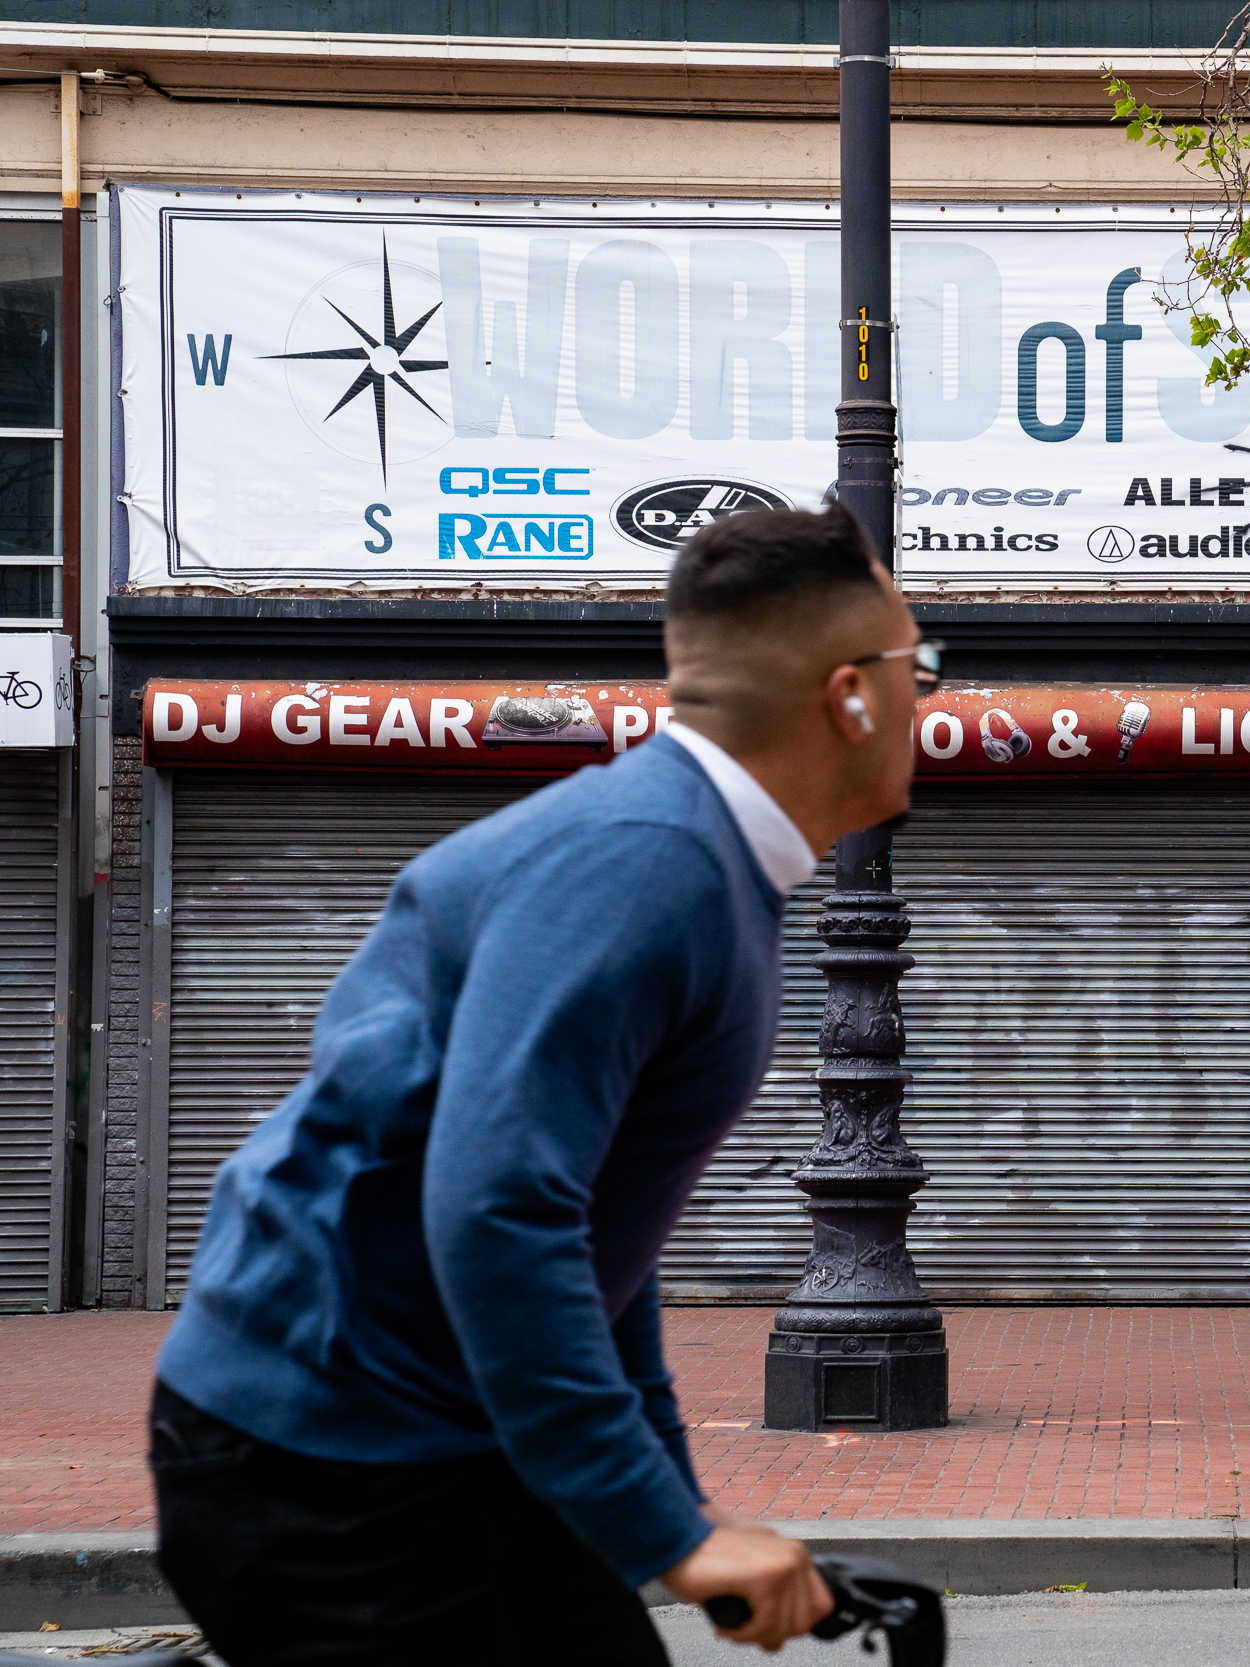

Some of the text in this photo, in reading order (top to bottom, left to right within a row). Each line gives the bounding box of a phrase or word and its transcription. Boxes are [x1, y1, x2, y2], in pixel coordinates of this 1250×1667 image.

[187, 334, 232, 386] W
[437, 236, 1002, 443] WORLD
[1017, 266, 1142, 443] of
[858, 306, 869, 381] 1010
[439, 467, 590, 498] QSC
[364, 503, 392, 554] S
[439, 514, 593, 560] RANE
[893, 526, 1059, 551] chnics
[152, 692, 241, 744] DJ
[270, 694, 477, 749] GEAR
[1047, 713, 1091, 759] &
